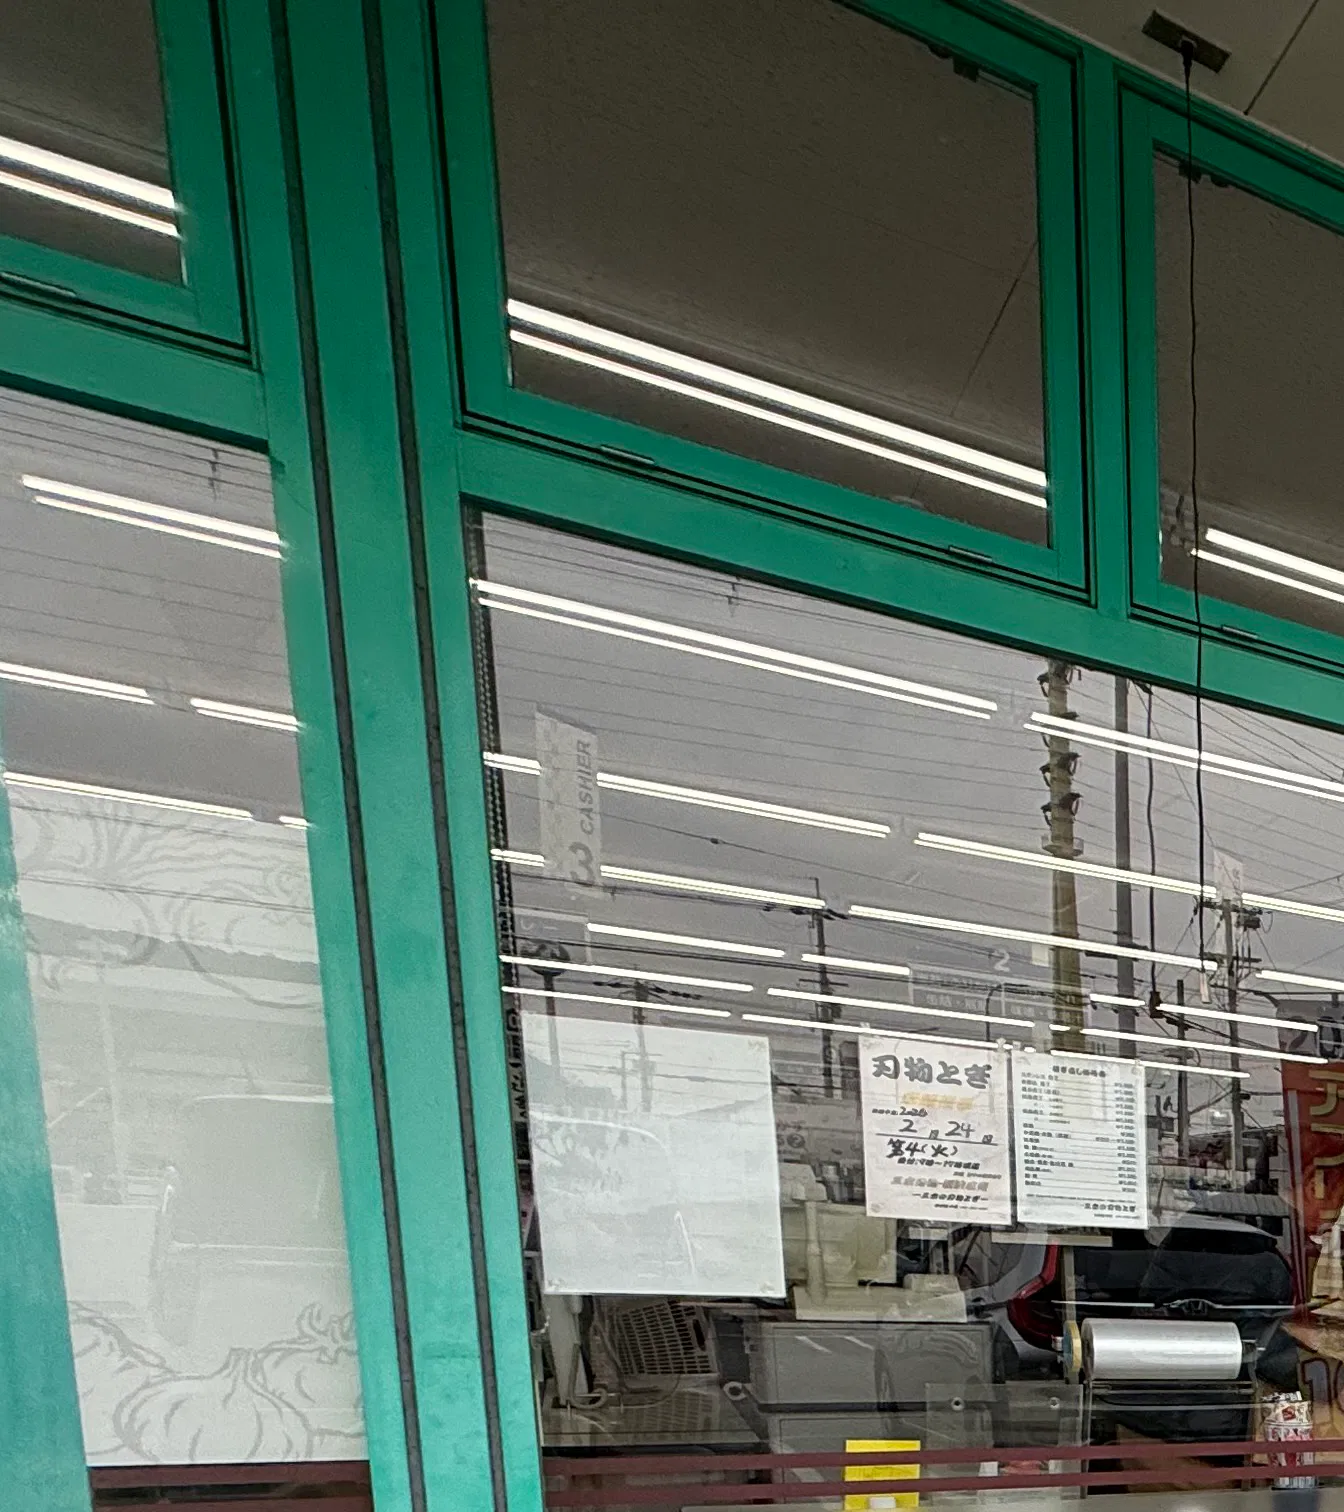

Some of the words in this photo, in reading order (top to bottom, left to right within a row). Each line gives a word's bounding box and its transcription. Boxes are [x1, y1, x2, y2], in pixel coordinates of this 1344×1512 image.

[576, 739, 595, 836] CASHIER
[872, 1055, 992, 1090] 刃物とぎ
